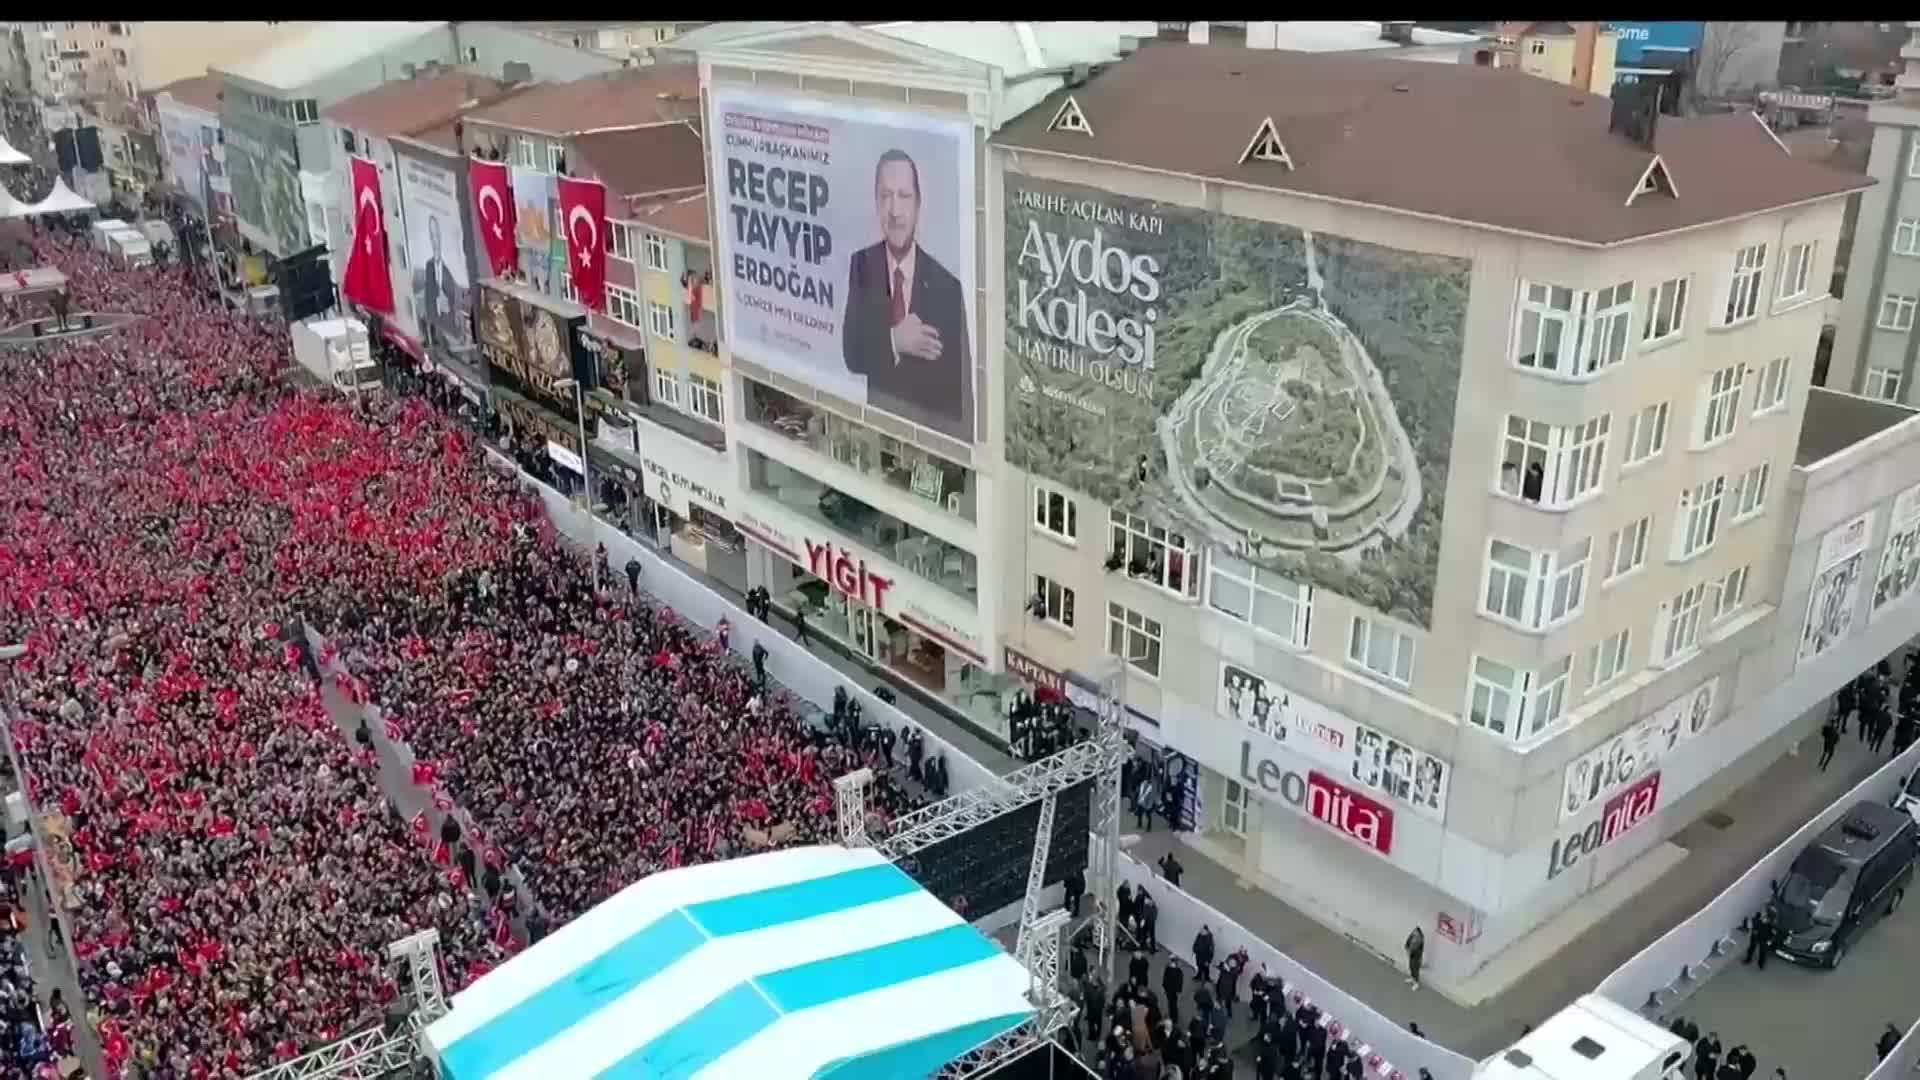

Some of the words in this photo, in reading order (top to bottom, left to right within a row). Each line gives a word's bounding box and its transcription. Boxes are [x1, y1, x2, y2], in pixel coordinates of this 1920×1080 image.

[727, 157, 829, 216] RECEP
[1071, 200, 1125, 226] AÇILAN
[1129, 212, 1163, 236] KAPI
[731, 203, 832, 266] TAYYİP
[1018, 219, 1160, 301] Aydos
[734, 252, 834, 309] ERDOĞAN
[1018, 279, 1157, 369] Kalesi
[1018, 335, 1086, 377] HAYIRLI
[1089, 360, 1153, 401] OLSUN
[804, 537, 890, 609] YİĞİT
[1240, 740, 1382, 848] Leonita
[1547, 784, 1655, 880] Leonita
